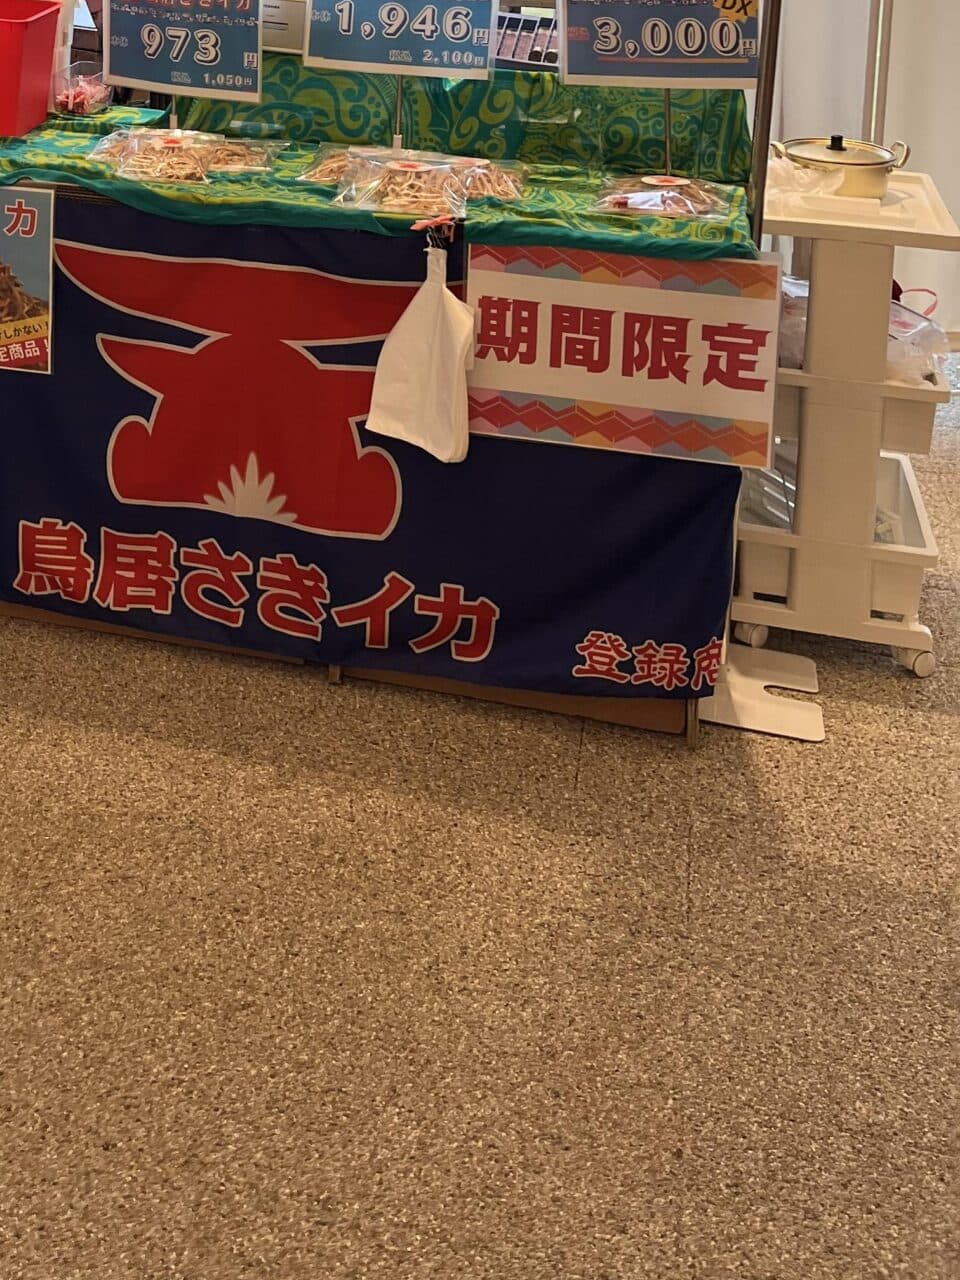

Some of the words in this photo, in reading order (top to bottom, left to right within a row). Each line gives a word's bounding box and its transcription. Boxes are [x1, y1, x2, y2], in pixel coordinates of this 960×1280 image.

[475, 295, 774, 393] 期間限定
[13, 518, 501, 662] 鳥居さきイカ
